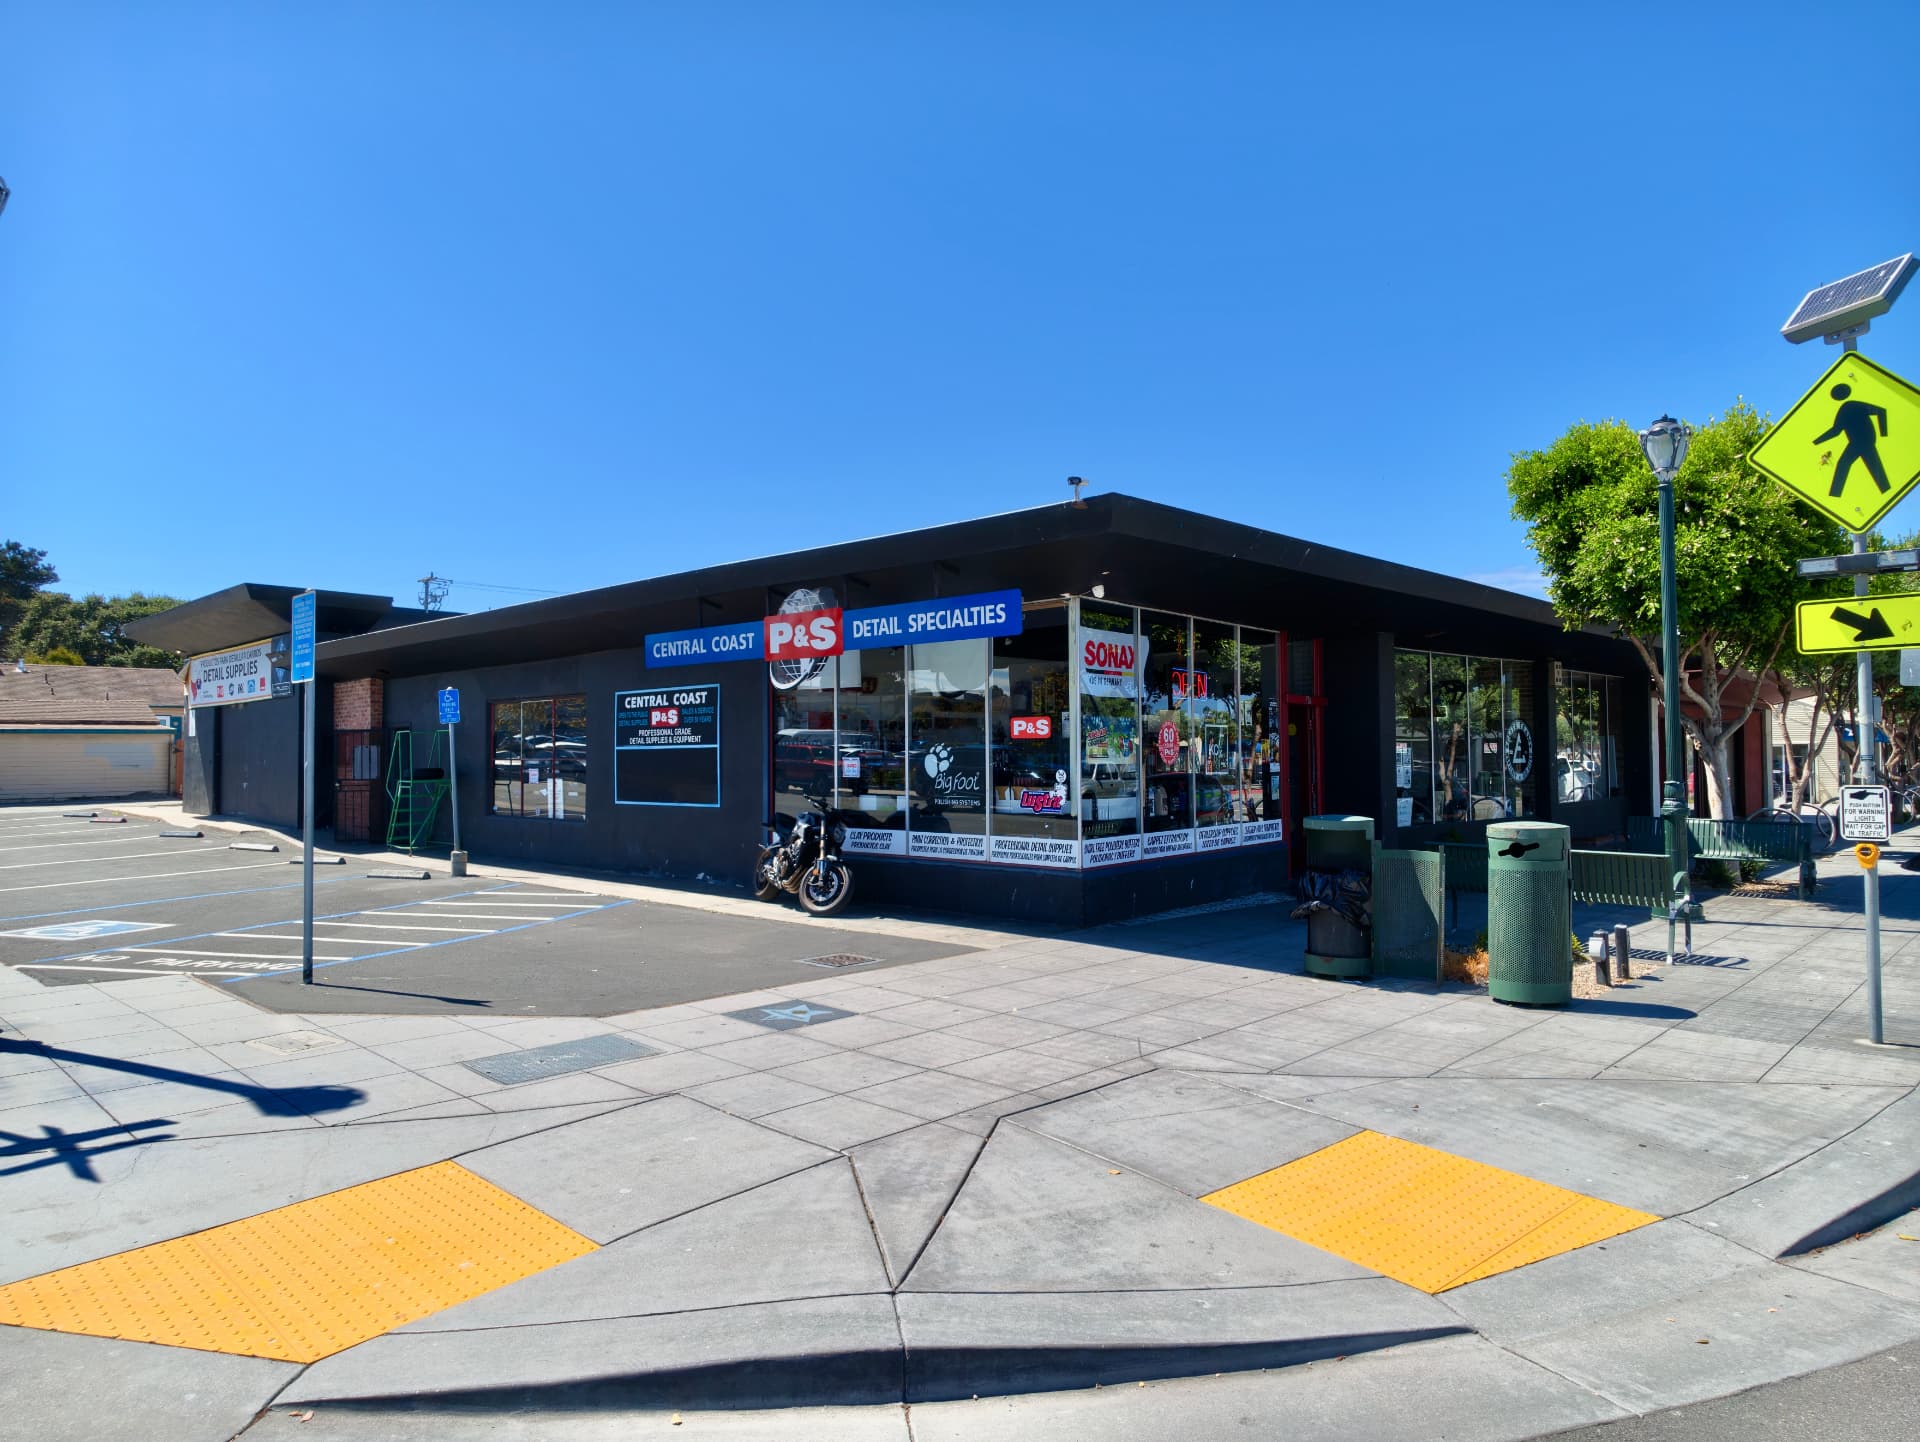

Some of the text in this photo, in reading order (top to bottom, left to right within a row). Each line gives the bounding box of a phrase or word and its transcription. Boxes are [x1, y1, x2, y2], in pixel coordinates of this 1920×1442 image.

[653, 603, 1006, 658] CENTRAL COAST P&S DETAIL SPECIALTIES
[203, 660, 258, 682] DETAIL SUPPLIES
[625, 691, 708, 708] CENTRAL COAST
[651, 709, 678, 725] P&S
[638, 728, 674, 736] PROFESSIONAL
[1013, 719, 1049, 736] P&S
[1163, 728, 1174, 742] 60
[646, 736, 668, 744] SUPPLIES
[673, 735, 701, 743] EQUIPMENT
[959, 799, 981, 807] SYSTEMS
[850, 831, 892, 841] CLAY PRODUCTS
[994, 839, 1030, 851] PROFESSIONAL
[1048, 842, 1073, 855] SUPPLIES
[65, 954, 303, 970] NO PARKING
